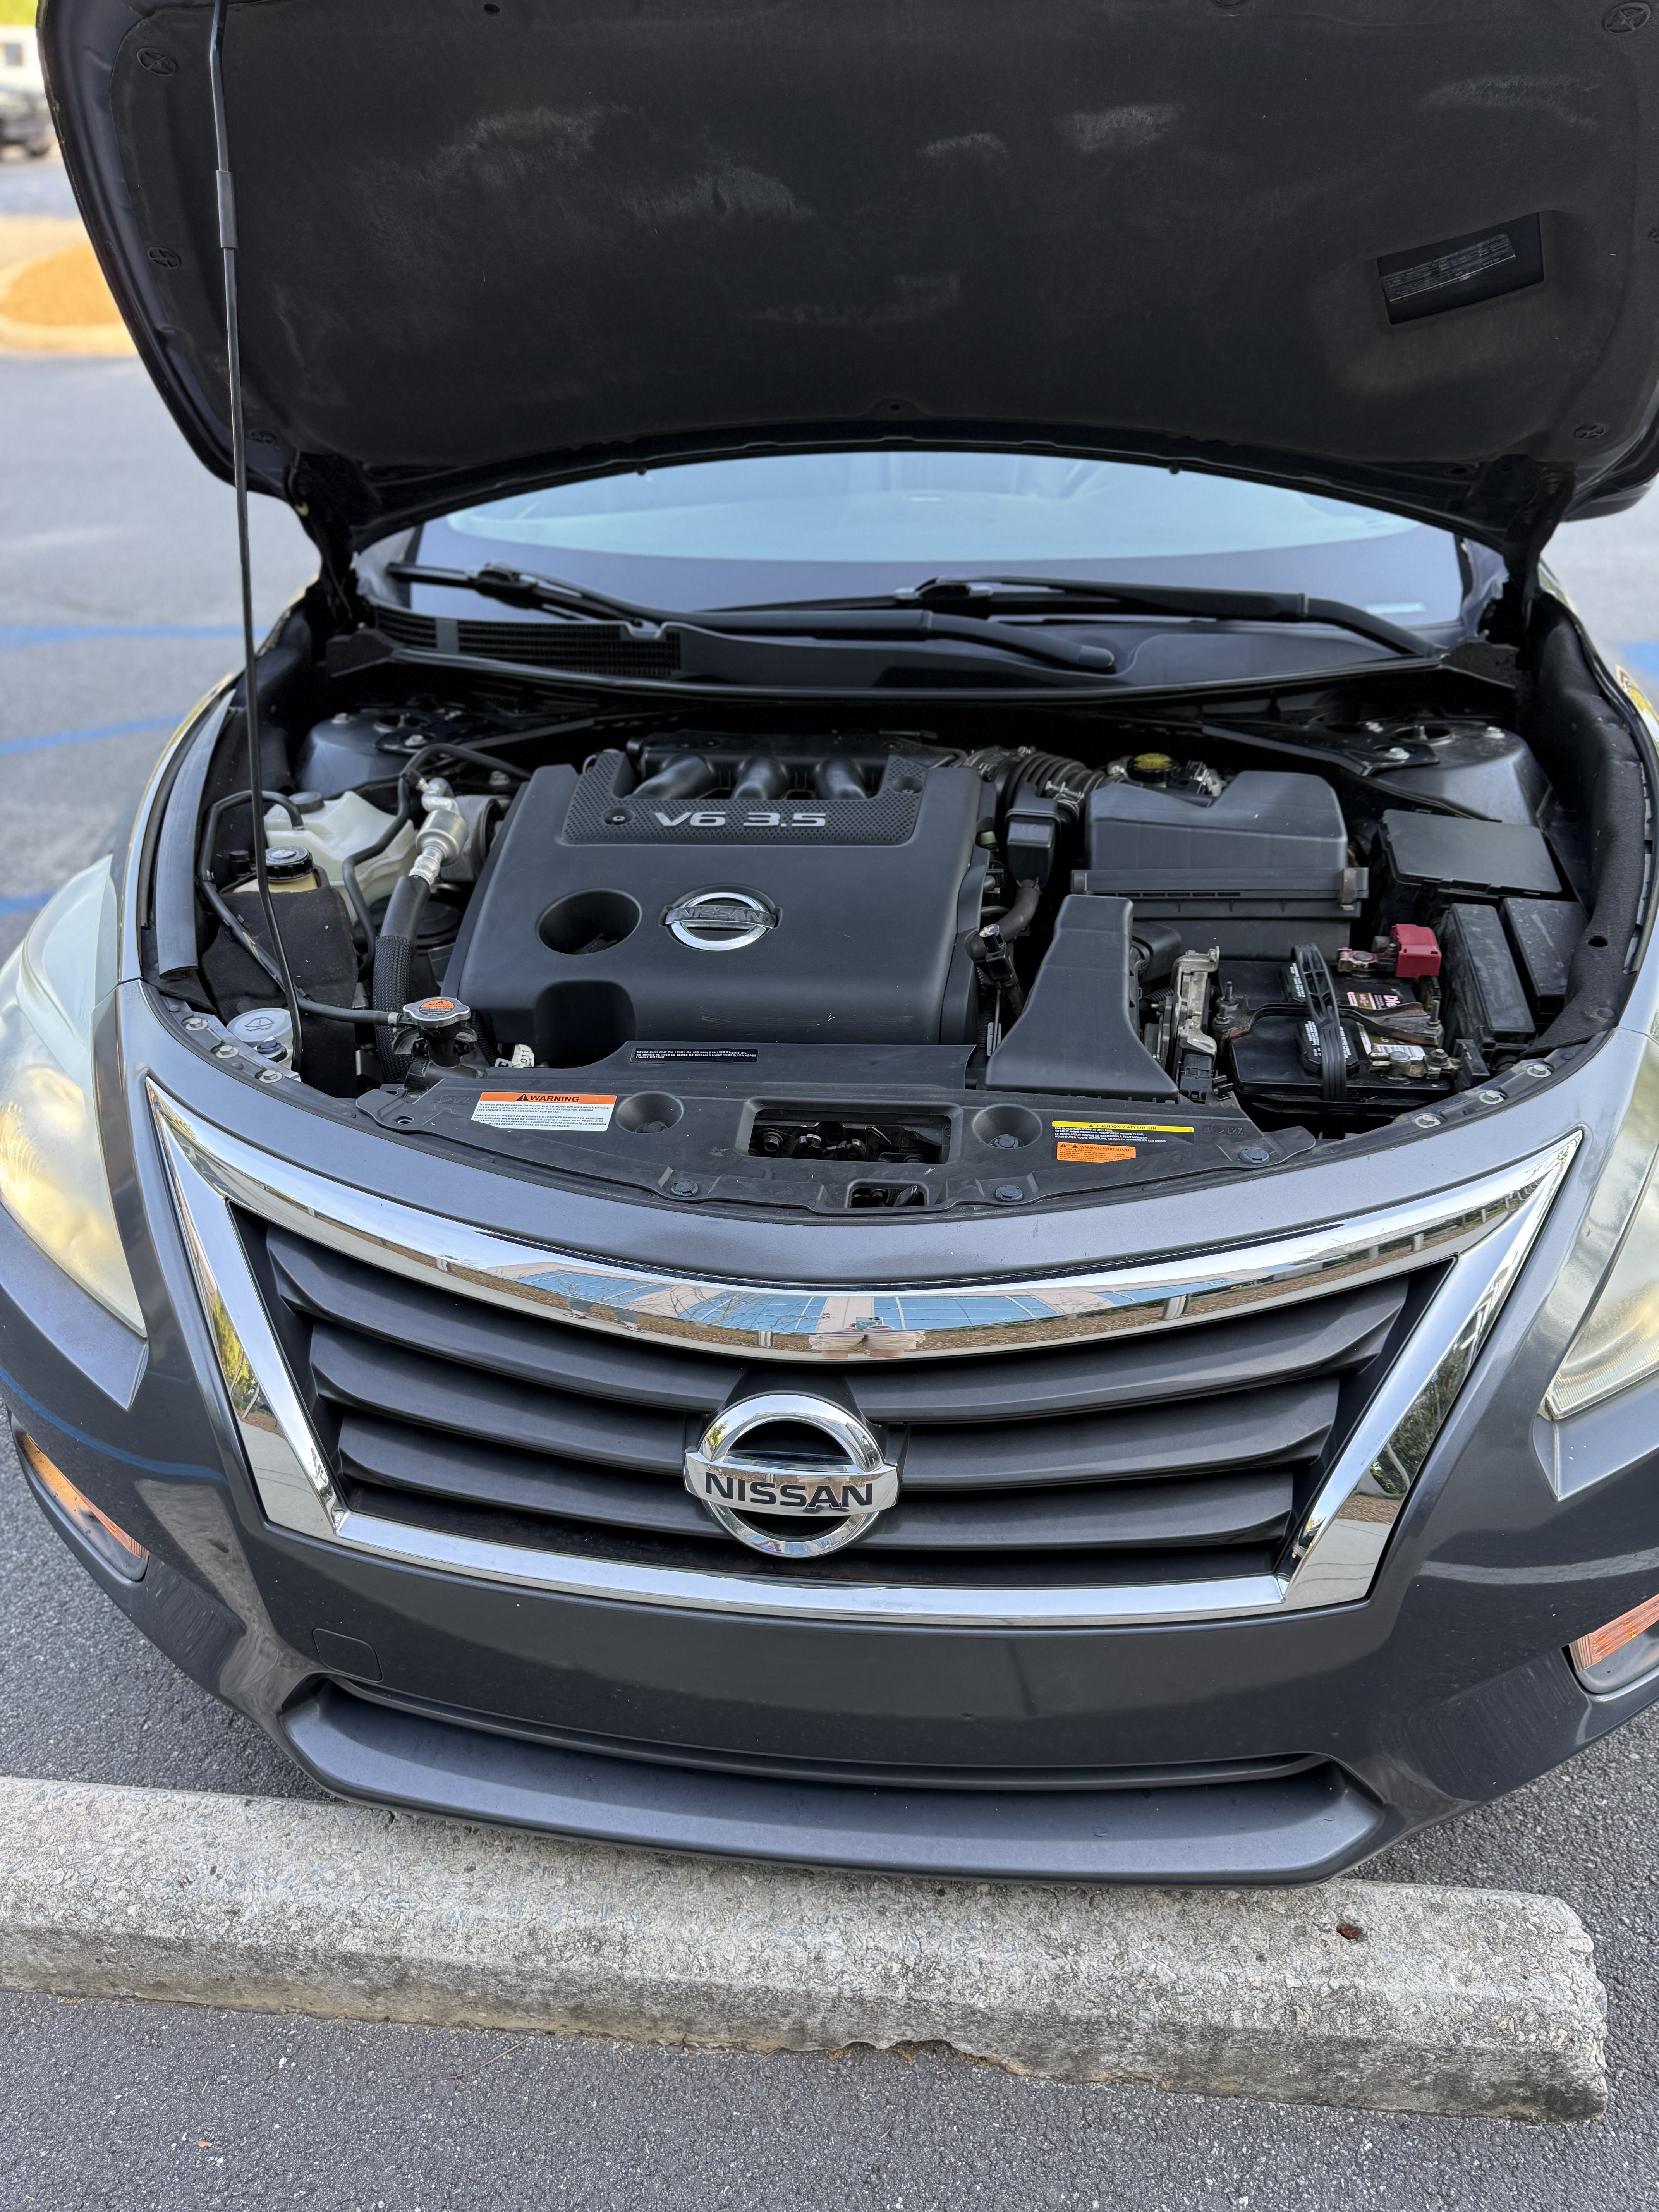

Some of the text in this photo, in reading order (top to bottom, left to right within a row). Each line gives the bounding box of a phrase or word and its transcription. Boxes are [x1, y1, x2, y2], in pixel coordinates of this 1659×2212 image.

[655, 812, 826, 827] V6 3.5
[678, 908, 764, 922] NISSAN
[705, 1472, 872, 1508] NISSAN
